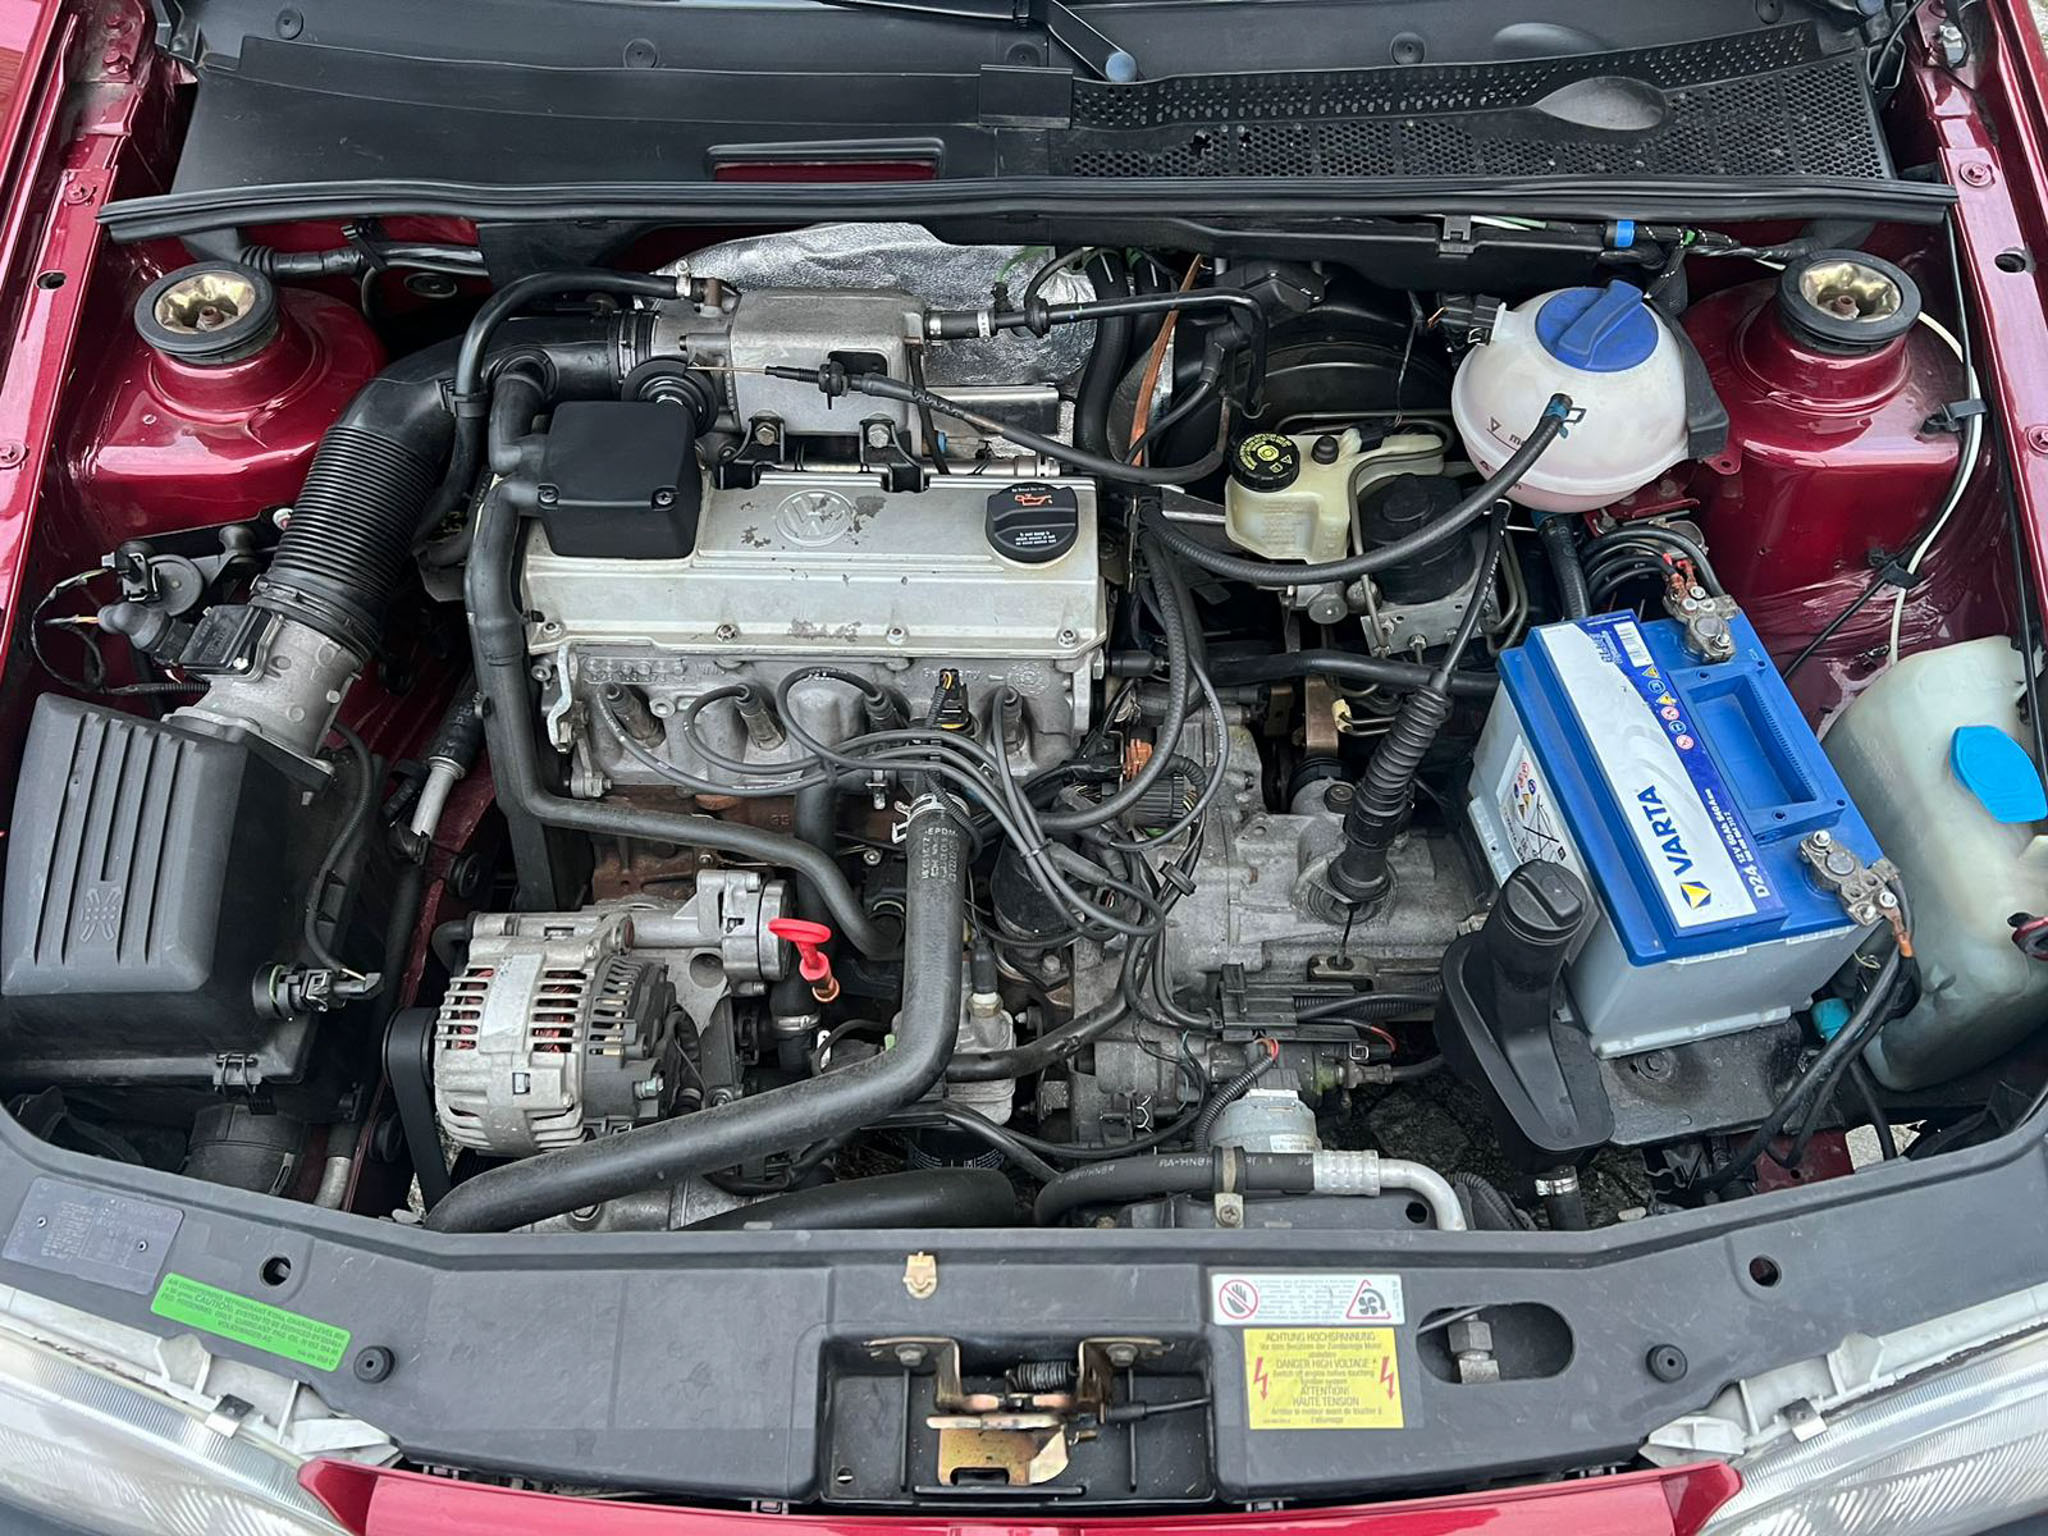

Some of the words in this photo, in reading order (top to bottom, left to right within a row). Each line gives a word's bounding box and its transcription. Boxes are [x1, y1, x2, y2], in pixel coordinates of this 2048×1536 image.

[1637, 785, 1693, 877] VARTA
[1721, 823, 1738, 846] 60Ah
[1732, 847, 1747, 864] 12V
[1743, 864, 1771, 899] D24
[1276, 1360, 1310, 1369] DANGER
[1312, 1360, 1333, 1369] HIGH
[1335, 1360, 1368, 1368] VOLTAGE
[1293, 1396, 1320, 1406] HAUTE
[1323, 1396, 1359, 1406] TENSION
